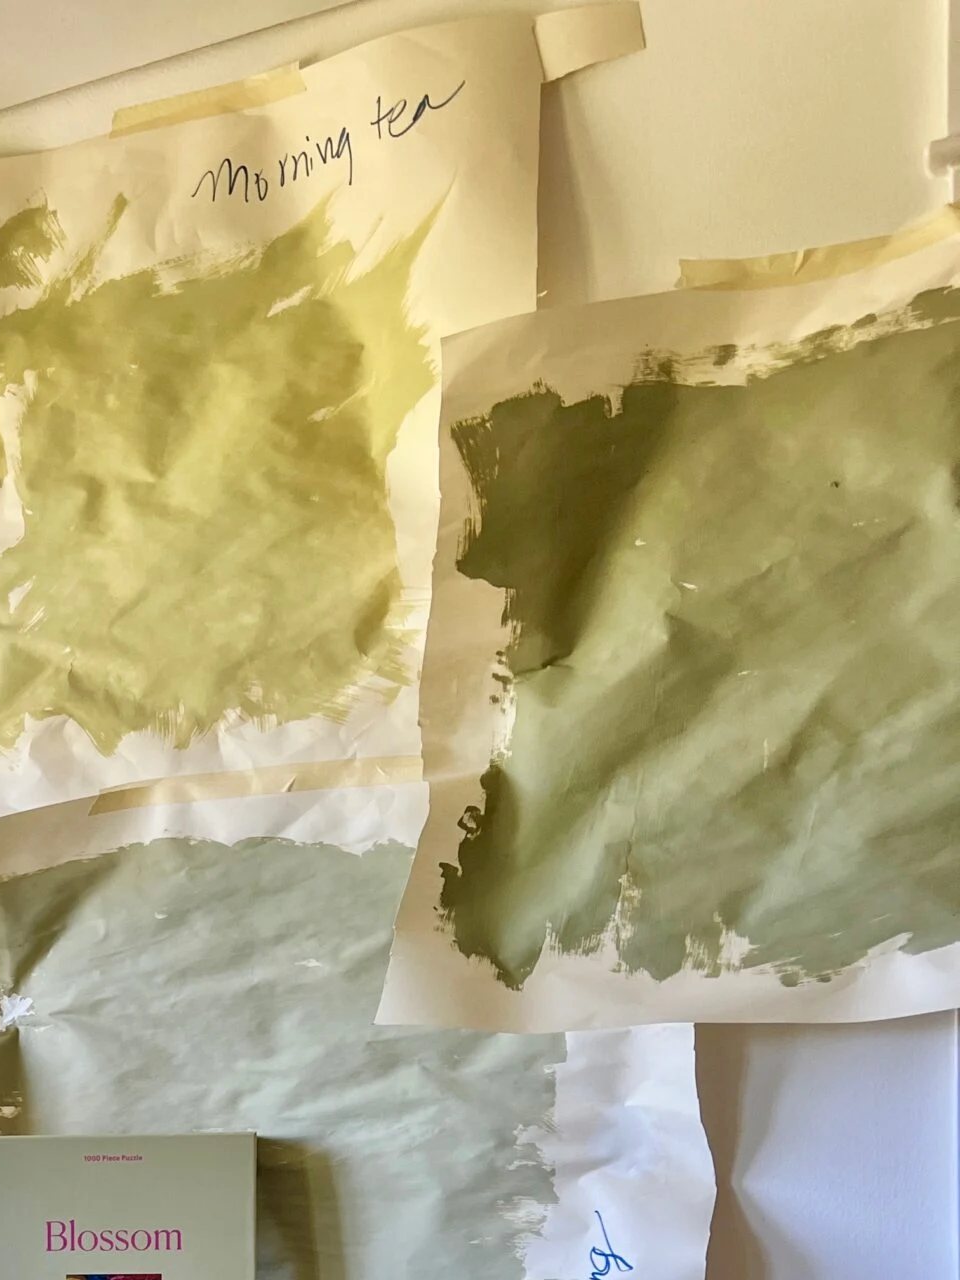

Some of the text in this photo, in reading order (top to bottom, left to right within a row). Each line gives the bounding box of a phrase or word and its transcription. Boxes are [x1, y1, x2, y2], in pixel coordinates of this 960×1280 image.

[191, 79, 466, 203] Morning tea
[84, 1153, 143, 1162] 1000 Piece Puzzle
[45, 1219, 183, 1252] Blossom
